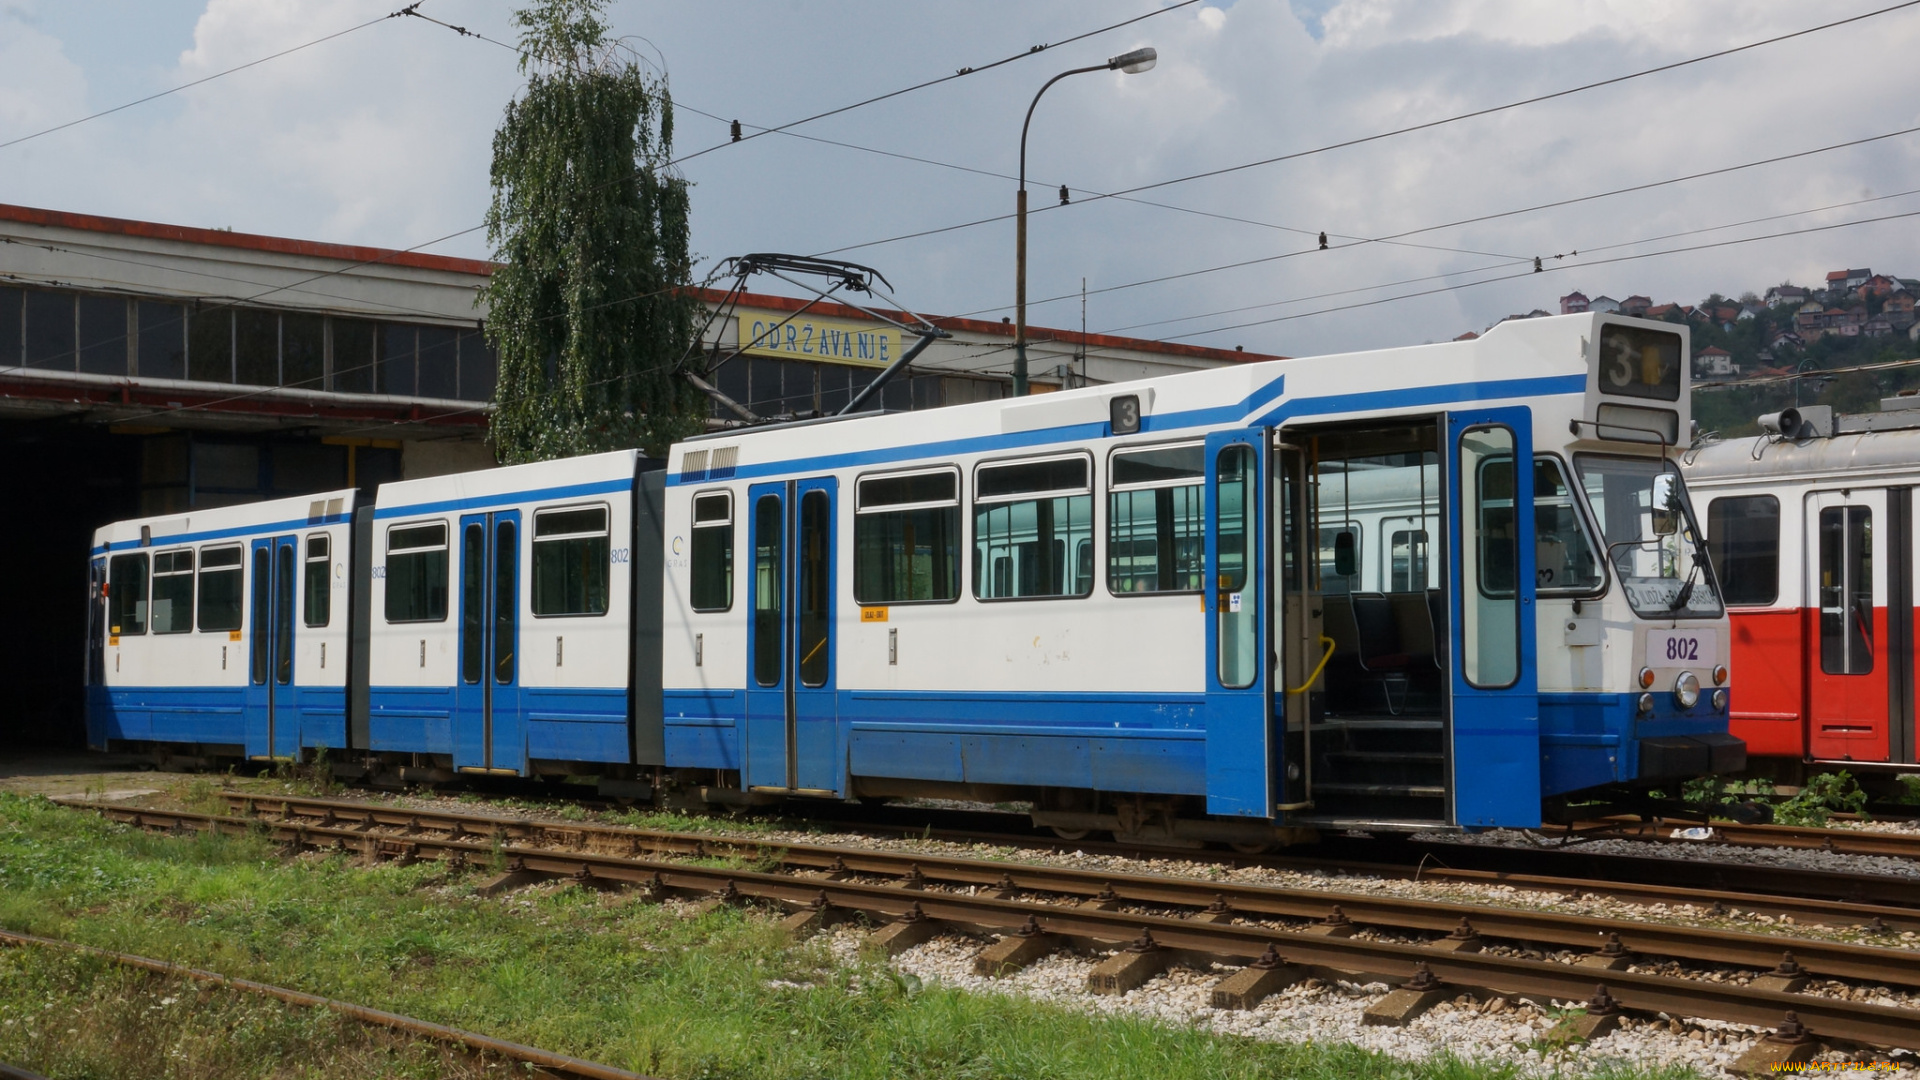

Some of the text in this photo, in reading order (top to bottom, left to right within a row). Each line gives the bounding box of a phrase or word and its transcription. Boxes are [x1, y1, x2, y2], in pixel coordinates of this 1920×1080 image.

[752, 320, 890, 362] ODRŽAVANJE
[1609, 334, 1632, 387] 3
[1122, 400, 1137, 427] 3
[610, 548, 629, 563] 802
[372, 566, 386, 579] 802
[1625, 585, 1640, 608] 3
[1666, 637, 1698, 661] 802
